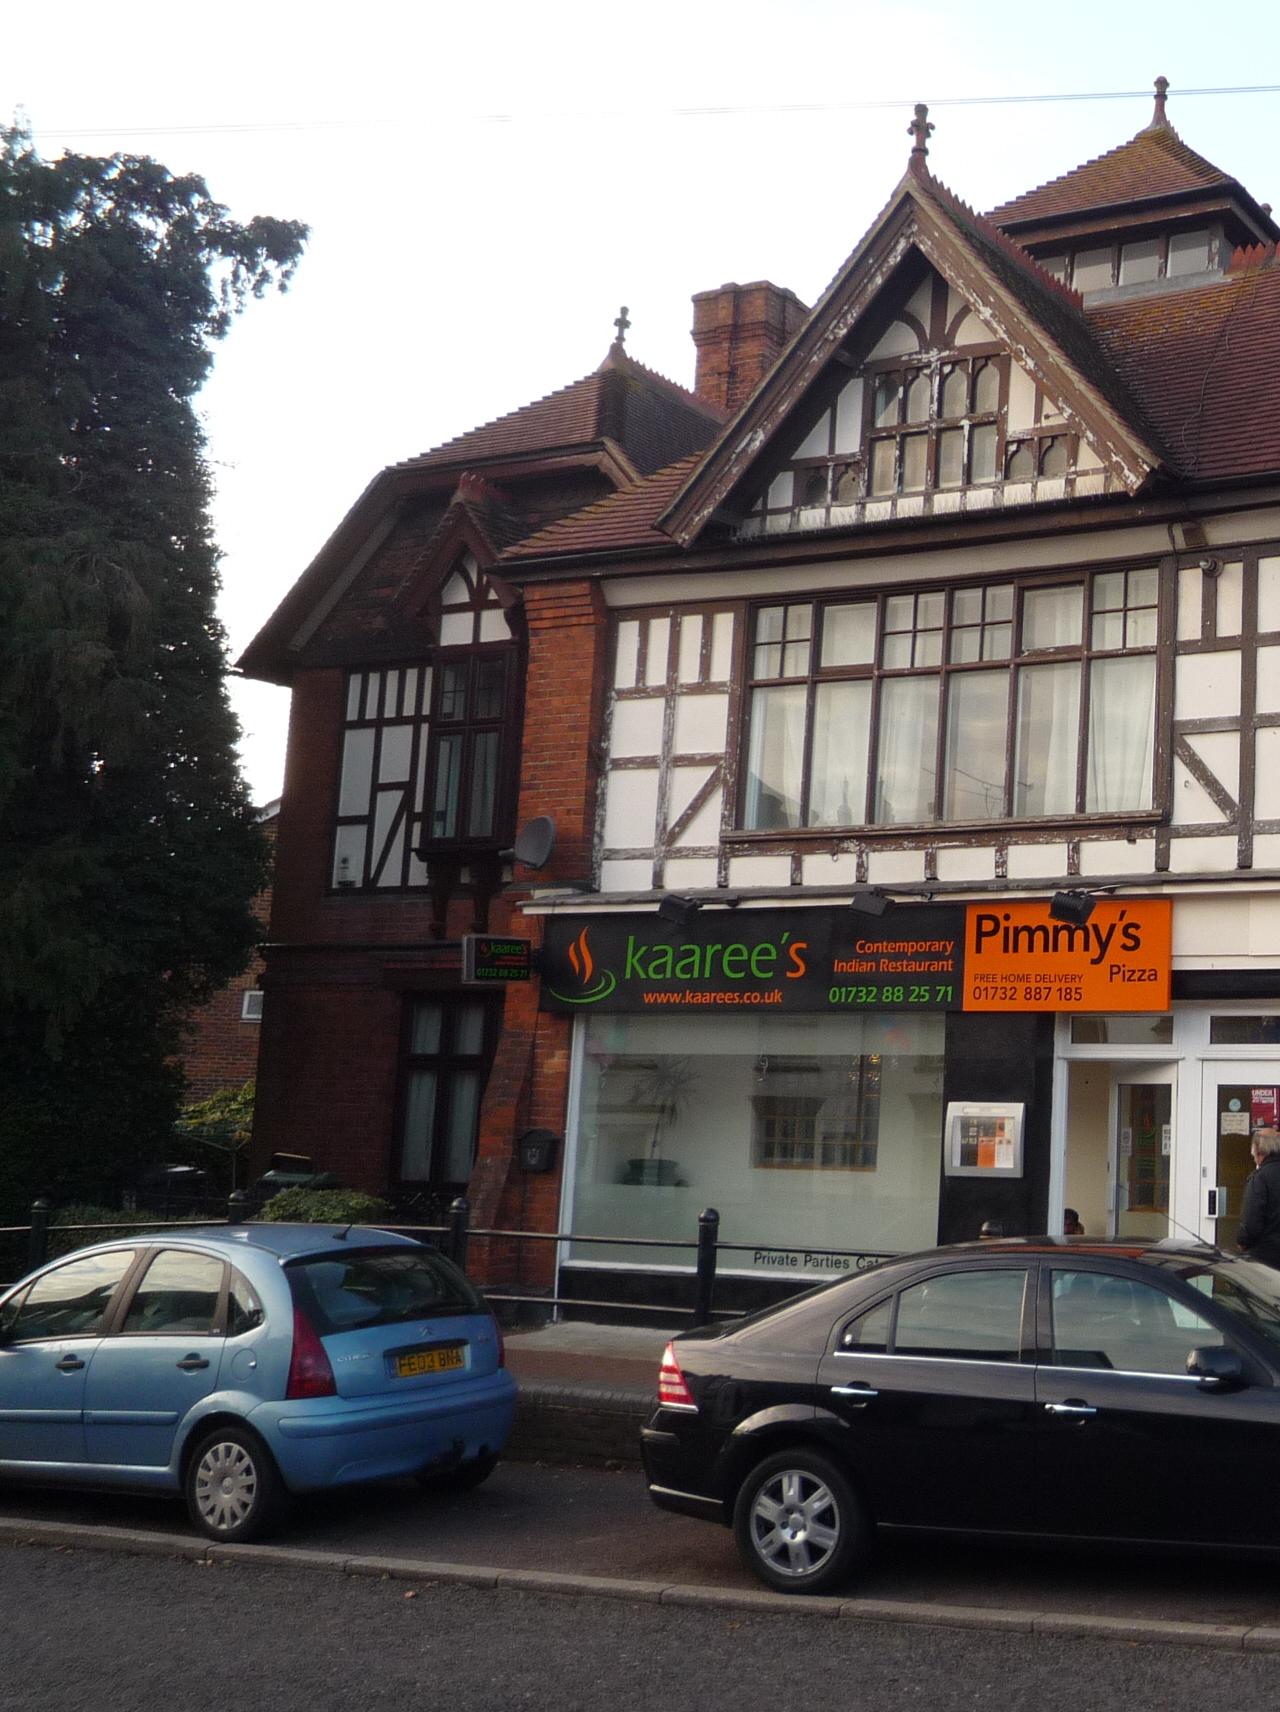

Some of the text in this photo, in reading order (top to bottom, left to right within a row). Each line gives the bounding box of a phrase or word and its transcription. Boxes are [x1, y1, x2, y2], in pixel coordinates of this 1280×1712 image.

[974, 909, 1142, 965] Pimmy's
[624, 931, 808, 981] kaaree's
[855, 938, 955, 956] Contemporary
[833, 958, 954, 974] Indian Restaurant
[1109, 963, 1158, 983] Pizza
[973, 973, 1084, 984] FREE HOME DELIVERY
[643, 988, 783, 1006] www.kaarees.co.uk
[828, 985, 954, 1003] 01732 88 25 71
[972, 986, 1083, 1001] 01732 887 185
[753, 1251, 798, 1267] Private
[803, 1253, 850, 1270] Parties
